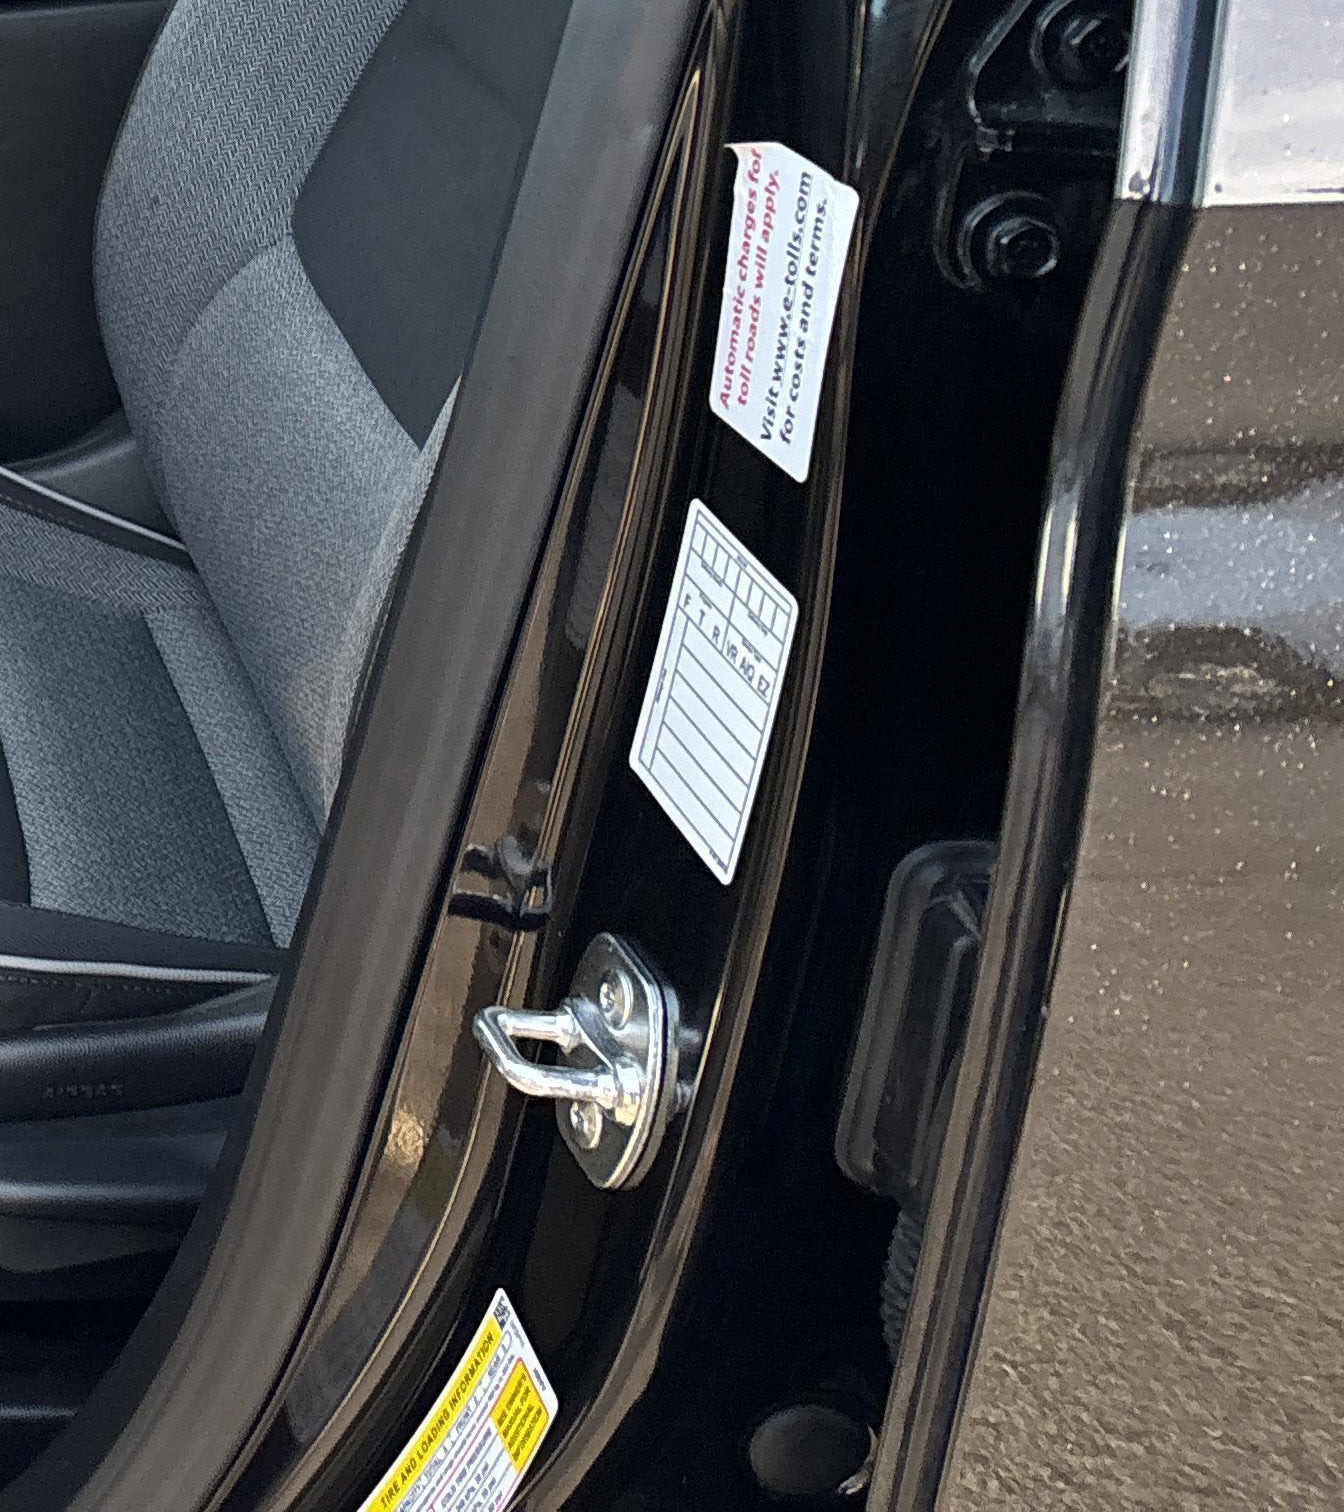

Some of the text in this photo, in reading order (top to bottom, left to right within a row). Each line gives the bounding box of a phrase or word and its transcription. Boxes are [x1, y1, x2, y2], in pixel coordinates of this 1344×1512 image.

[720, 148, 762, 409] Automatic charges for
[737, 170, 780, 406] toll roads will apply.
[760, 171, 812, 440] Visit www.e-tolls.com
[780, 199, 828, 444] for costs and terms.
[380, 1478, 401, 1509] TIRE
[400, 1452, 417, 1479] AND
[416, 1407, 450, 1458] LOADING
[449, 1332, 494, 1411] INFORMATION
